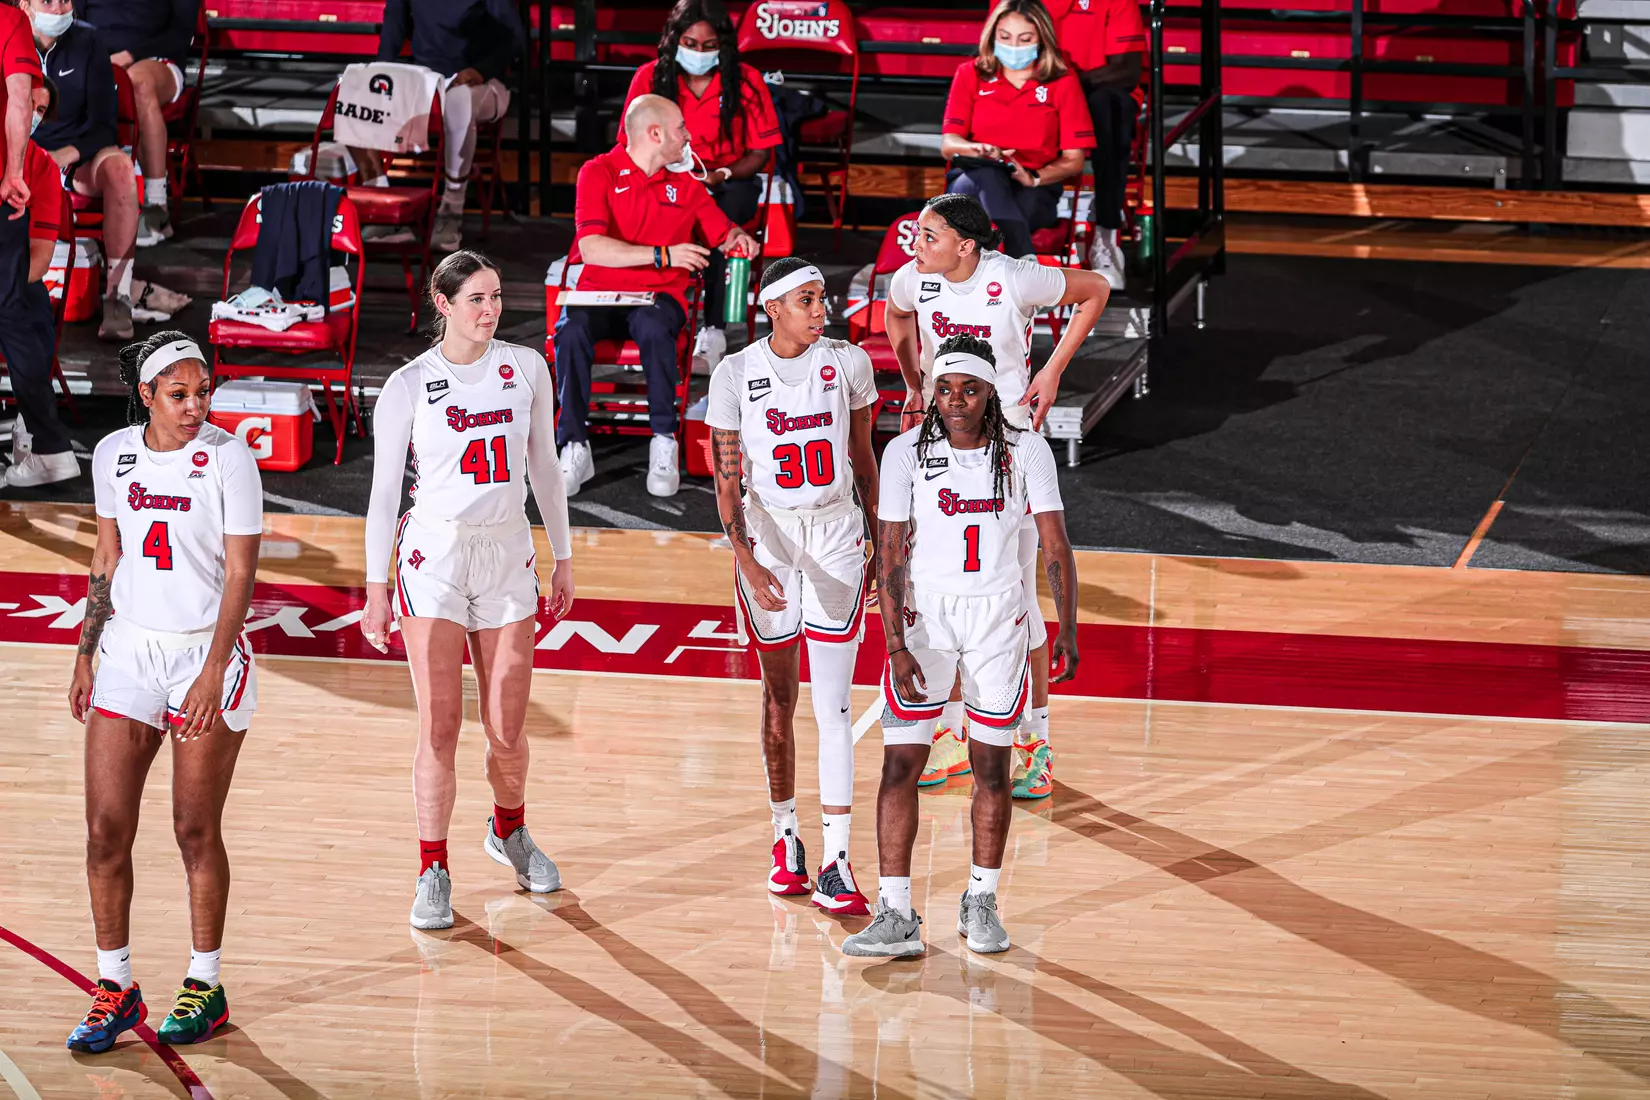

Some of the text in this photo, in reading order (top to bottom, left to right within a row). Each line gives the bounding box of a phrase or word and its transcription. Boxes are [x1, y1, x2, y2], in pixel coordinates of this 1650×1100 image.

[460, 435, 510, 485] 41
[773, 439, 835, 489] 30
[143, 521, 173, 570] 4
[963, 525, 981, 573] 1
